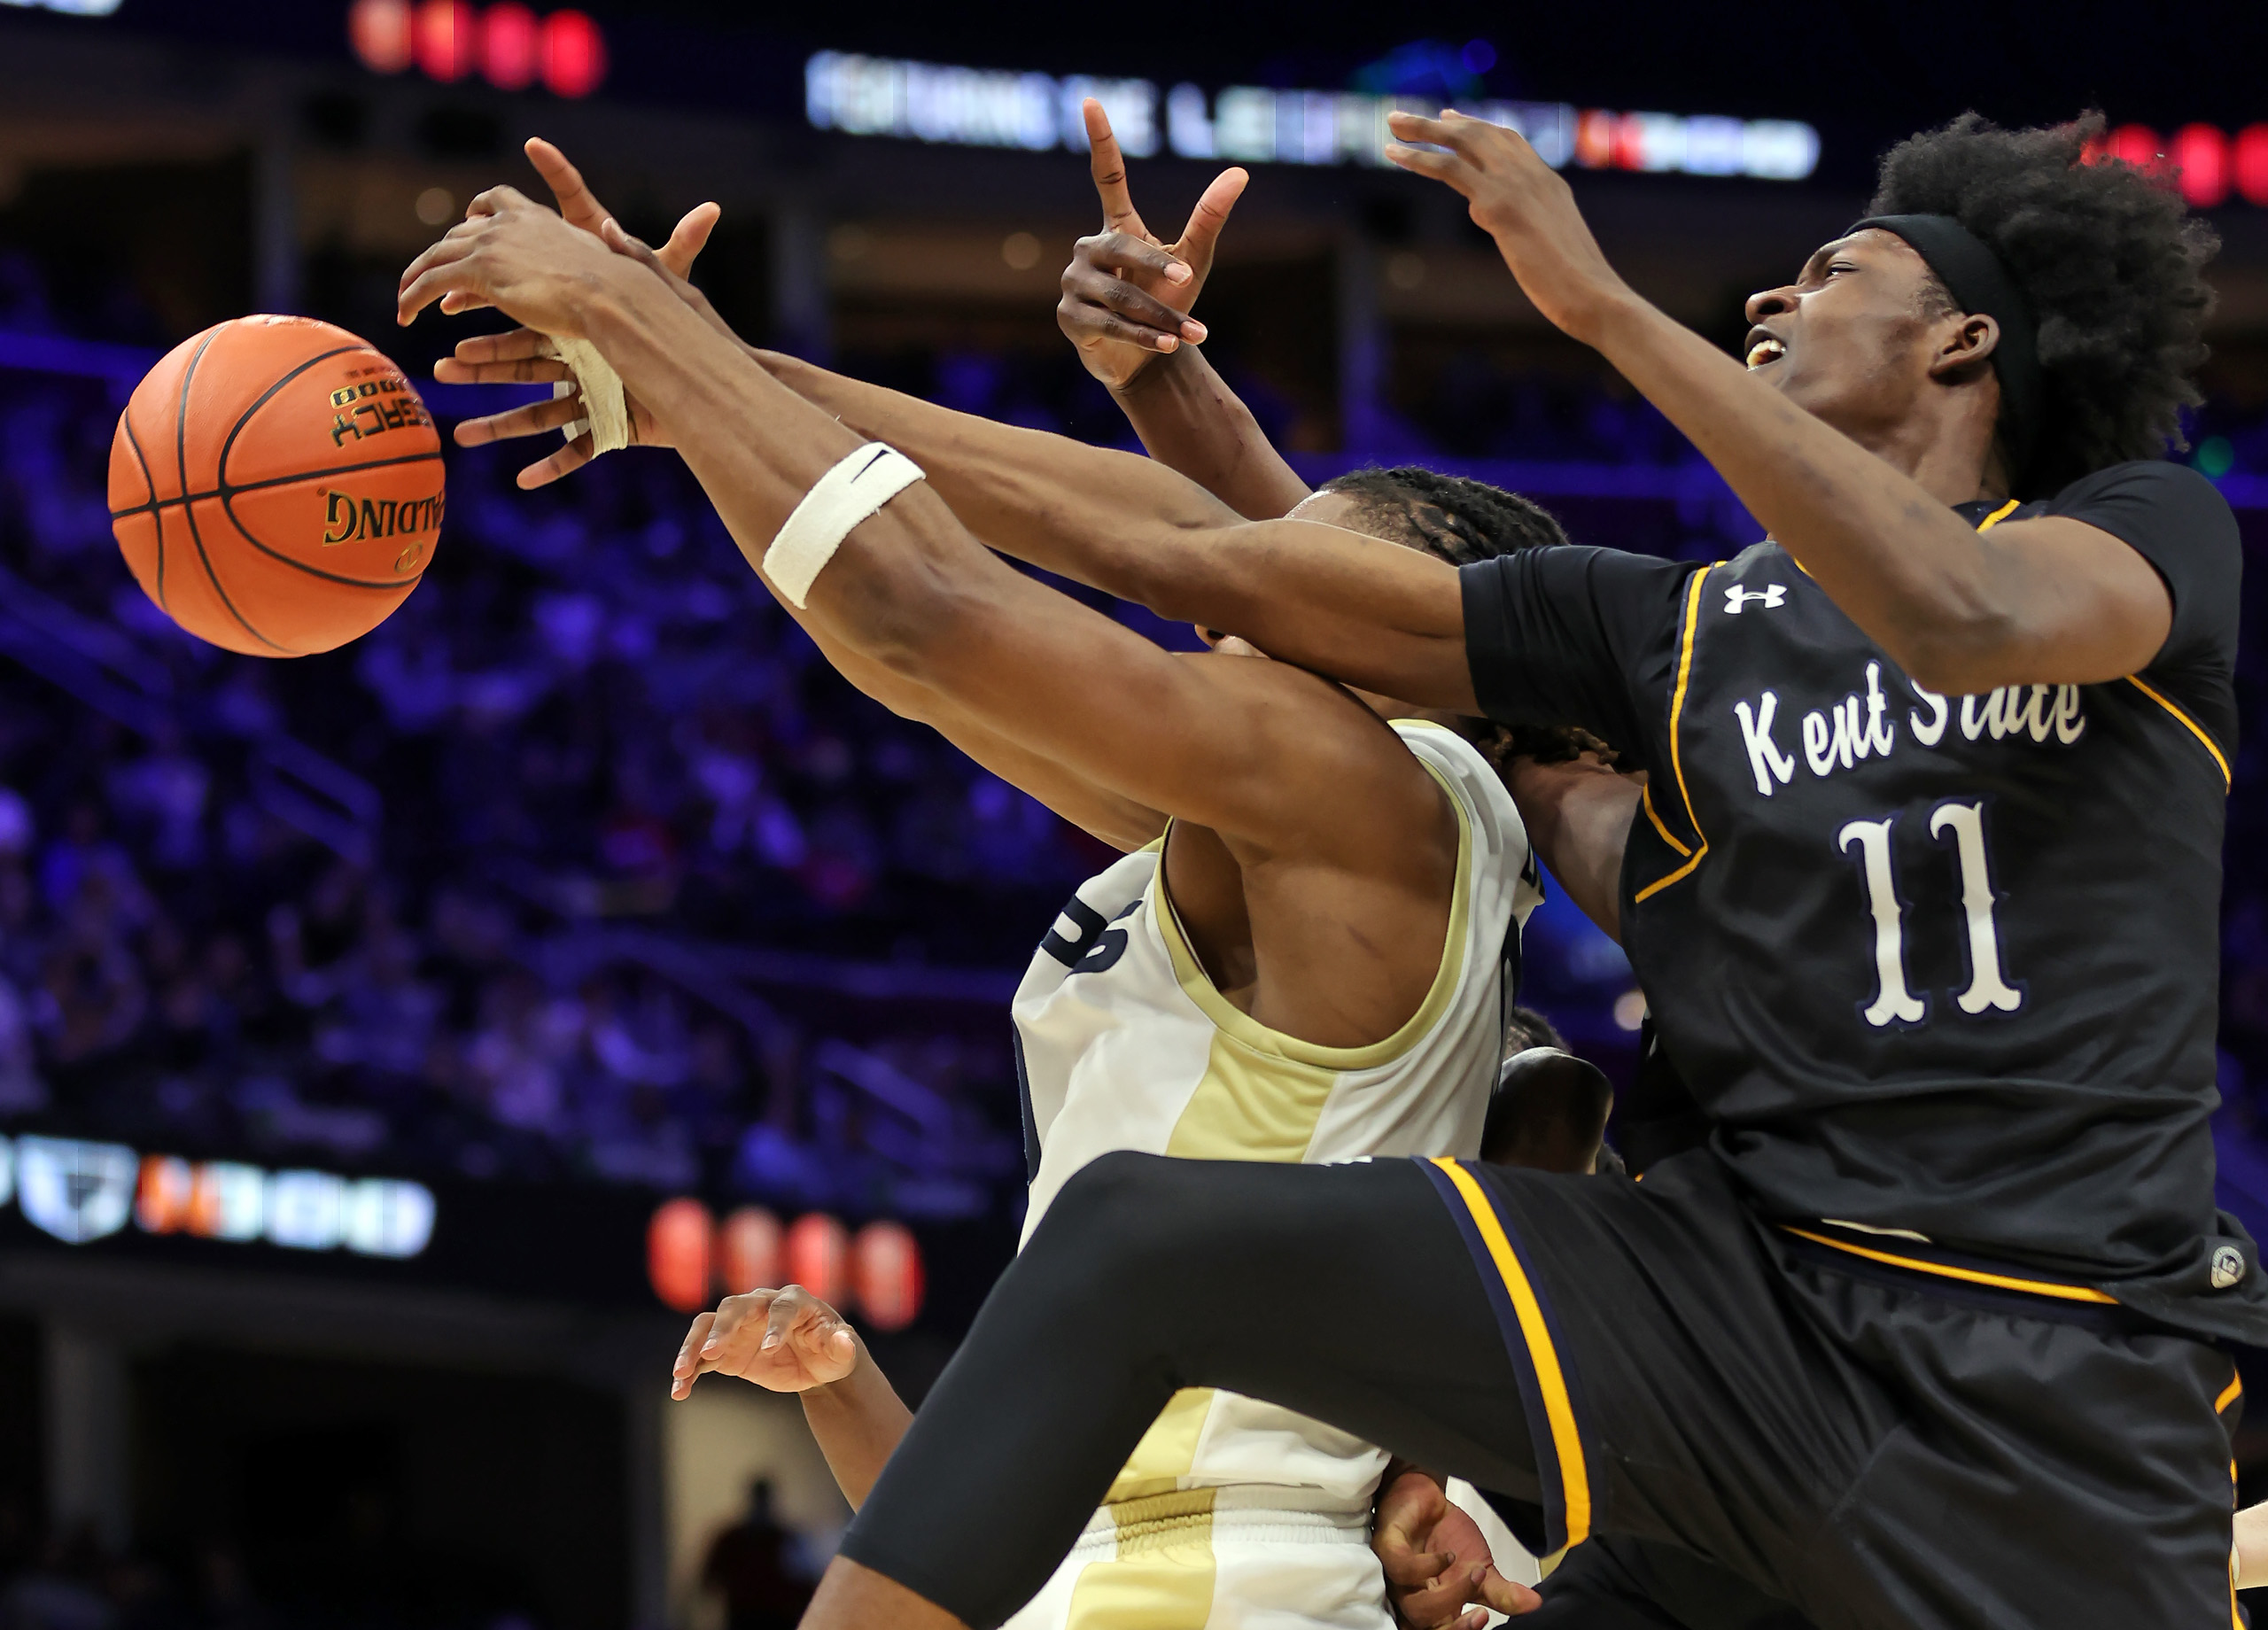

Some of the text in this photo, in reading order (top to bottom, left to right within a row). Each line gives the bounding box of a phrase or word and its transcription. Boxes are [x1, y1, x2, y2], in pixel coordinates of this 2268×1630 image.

[322, 489, 445, 547] ALDING
[1733, 659, 1895, 796] Kent
[1837, 801, 2022, 1027] 11
